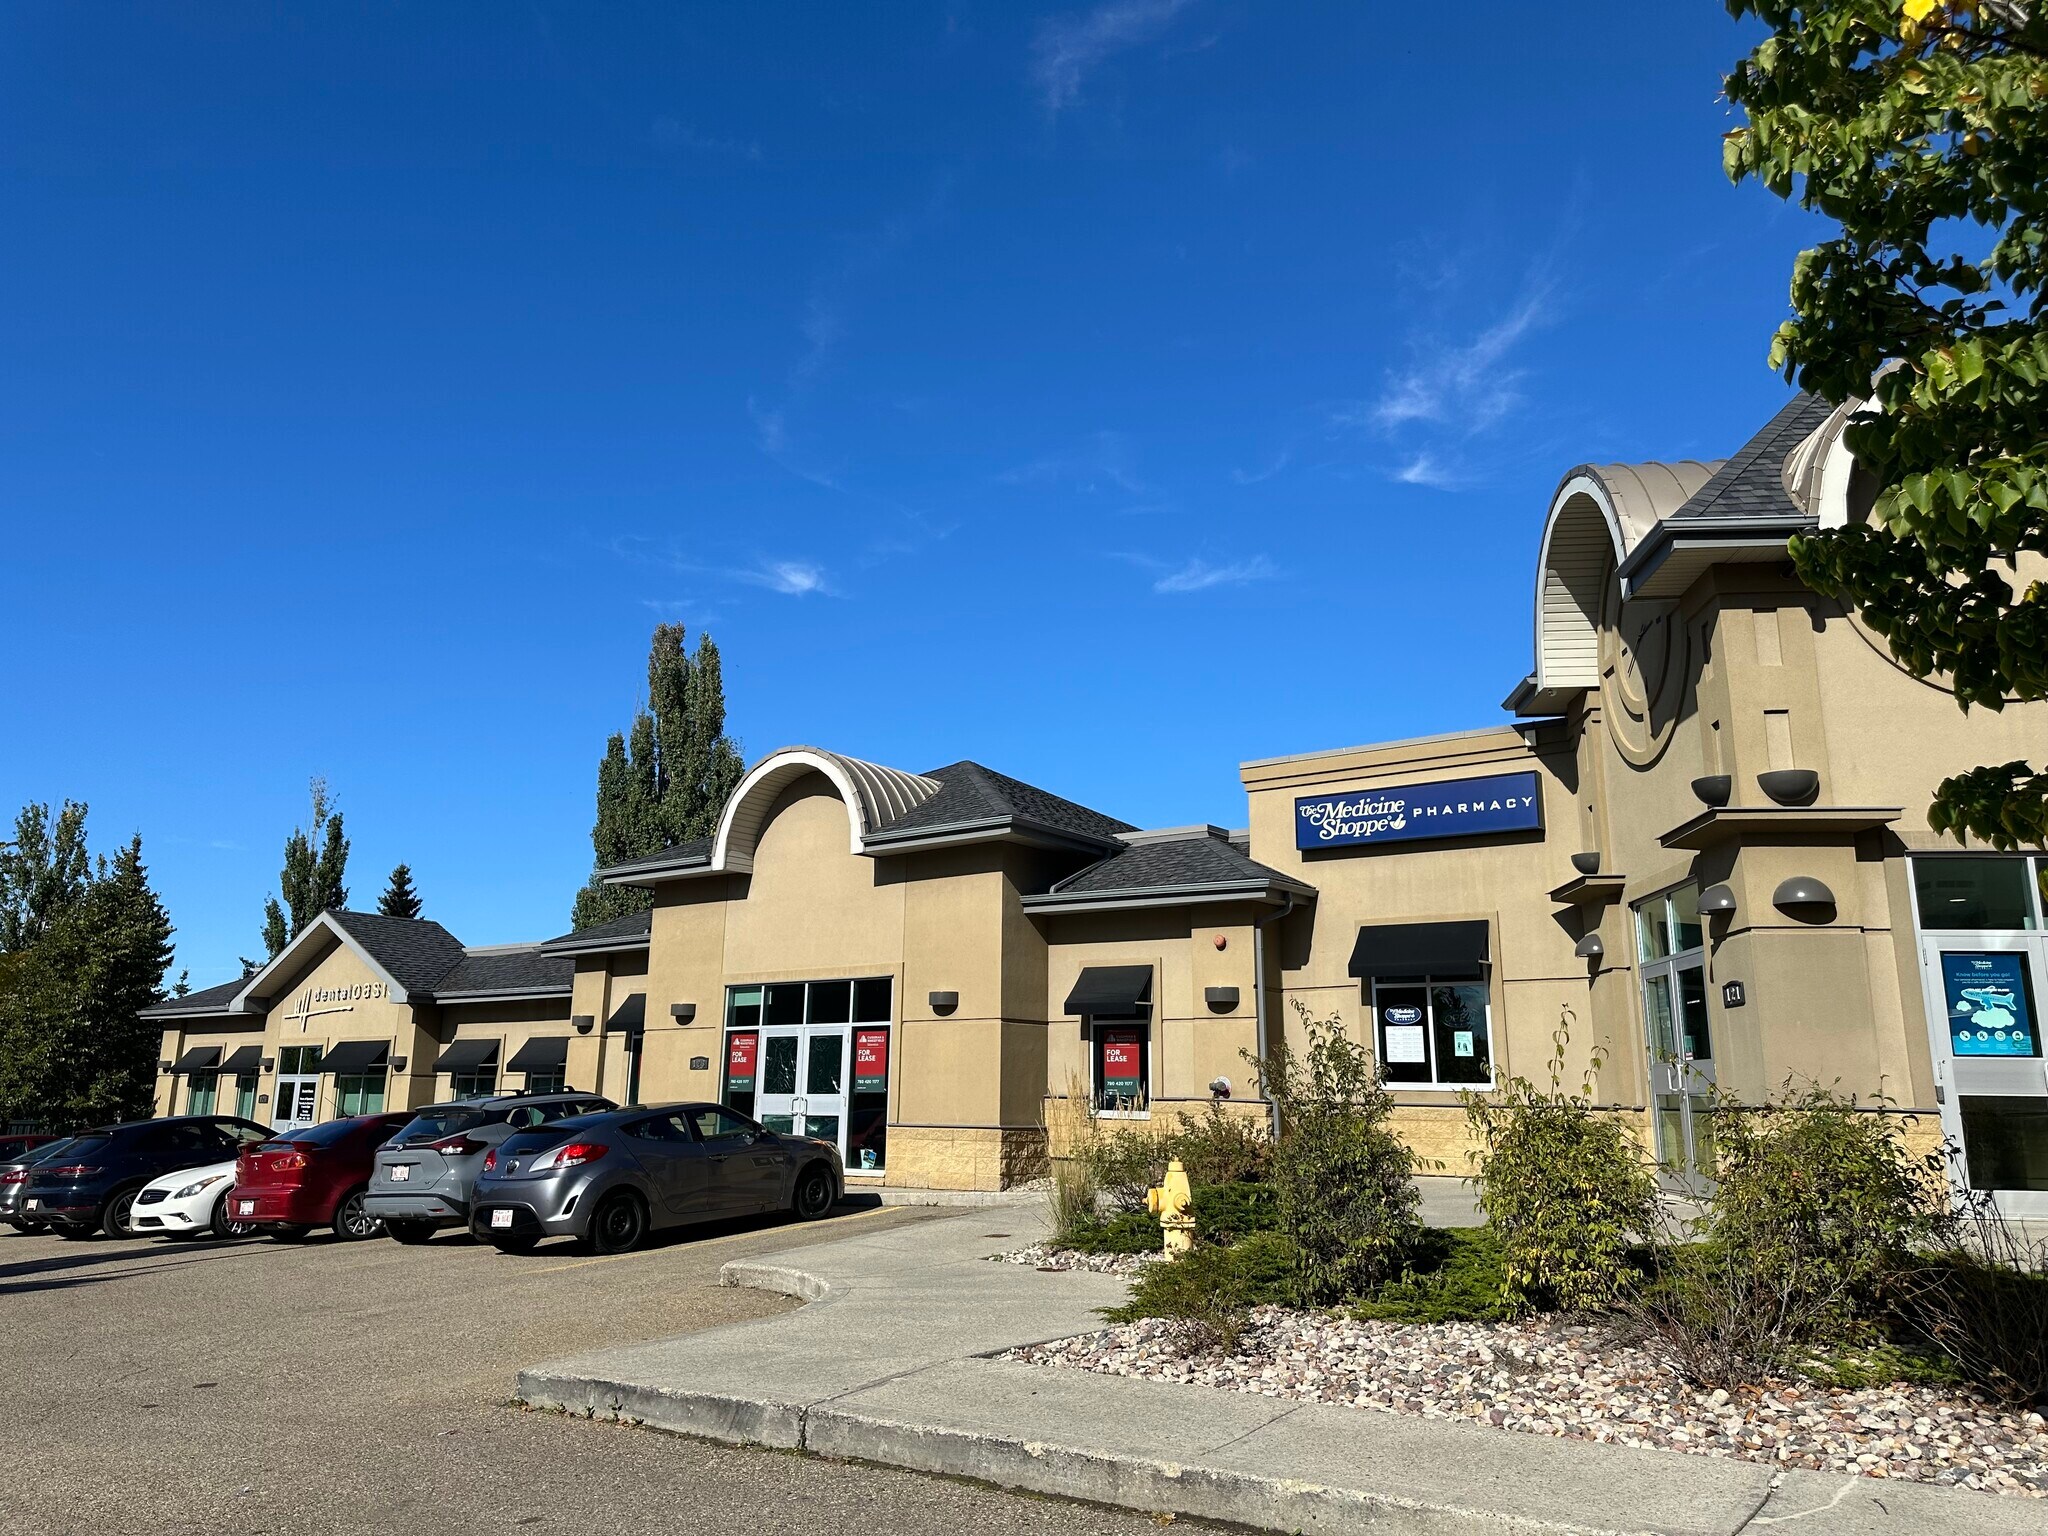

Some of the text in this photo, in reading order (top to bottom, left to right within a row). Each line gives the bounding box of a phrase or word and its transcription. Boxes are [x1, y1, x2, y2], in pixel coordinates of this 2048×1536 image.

[1299, 796, 1405, 826] The Medicine
[1413, 796, 1533, 818] PHARMACY
[1319, 816, 1388, 840] Shoppe
[1726, 986, 1741, 1002] 121
